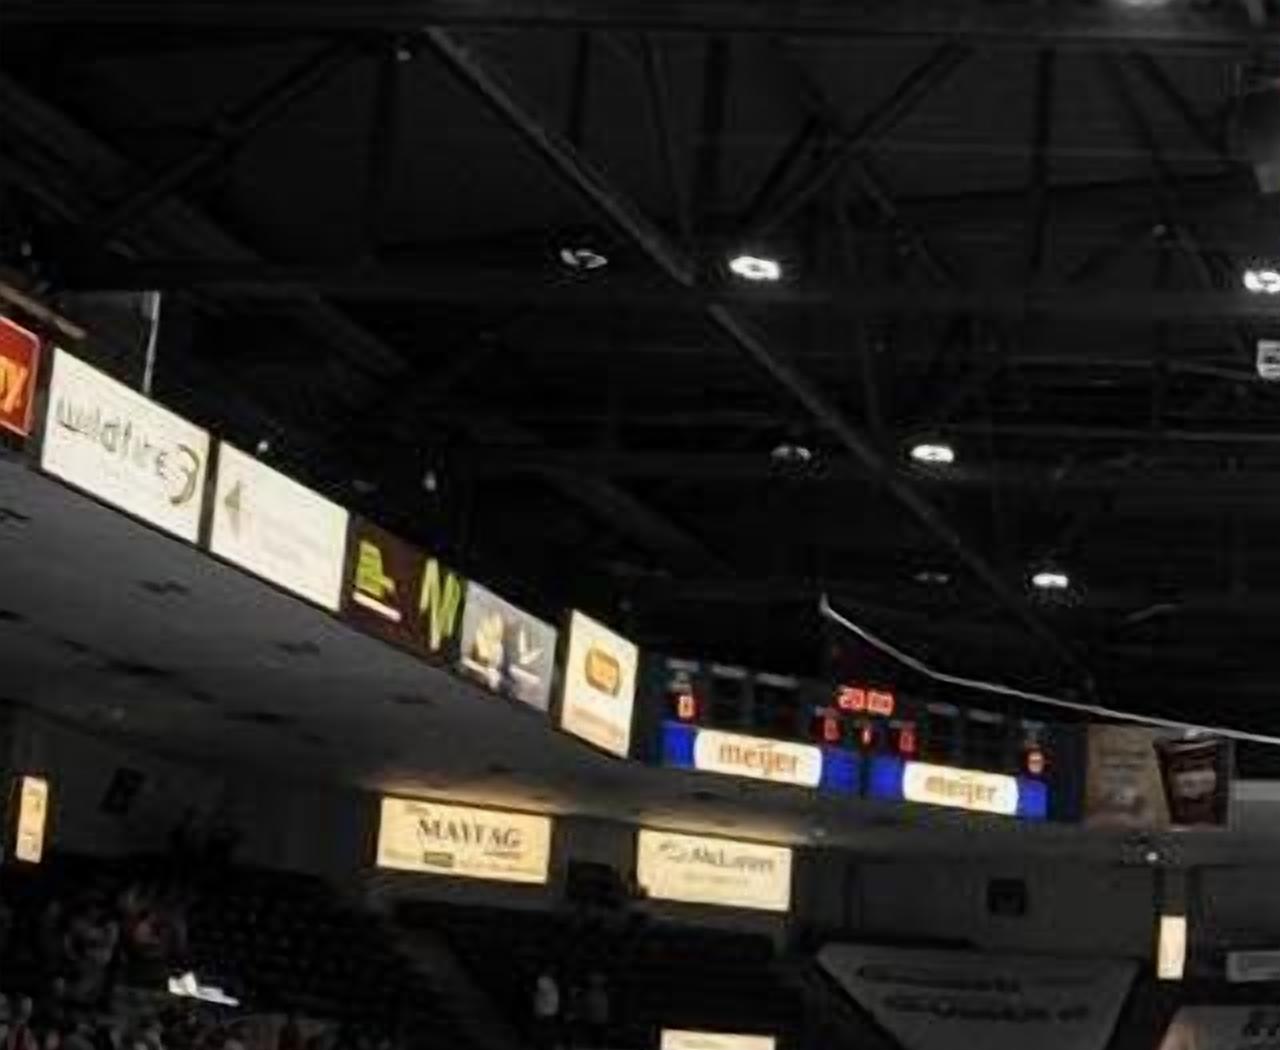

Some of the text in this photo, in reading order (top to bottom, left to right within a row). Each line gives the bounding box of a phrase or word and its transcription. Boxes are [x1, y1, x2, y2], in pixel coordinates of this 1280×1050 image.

[719, 740, 801, 778] meijer
[924, 770, 998, 805] meijer
[416, 816, 521, 849] MAYTAG
